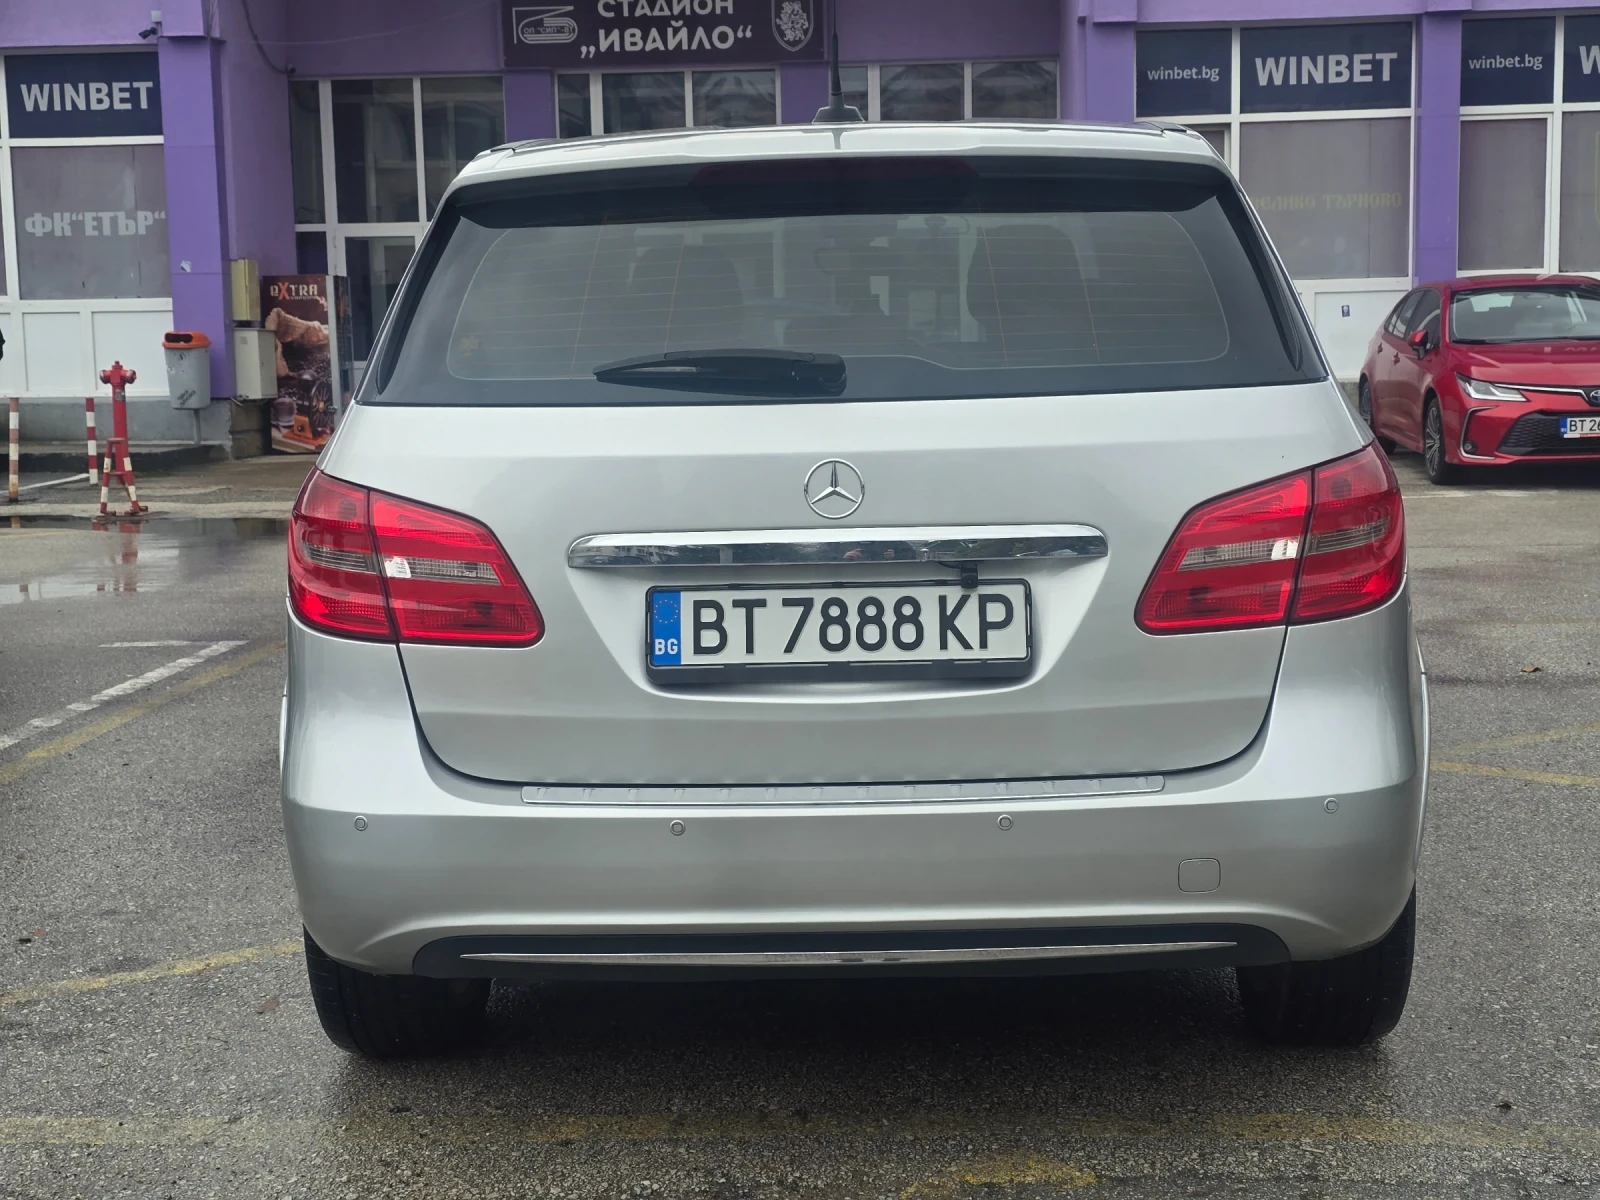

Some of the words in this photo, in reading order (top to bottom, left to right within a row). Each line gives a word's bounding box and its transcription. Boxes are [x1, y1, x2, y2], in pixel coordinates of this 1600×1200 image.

[597, 0, 734, 18] СТАДИОН
[1255, 52, 1398, 87] WINBET
[1468, 53, 1543, 71] winbet.bg
[1147, 65, 1220, 82] winbet.bg
[20, 81, 154, 112] WINBET
[1569, 419, 1586, 433] BT
[692, 597, 767, 655] BT
[781, 595, 924, 654] 7888
[938, 593, 1014, 651] KP
[654, 638, 679, 655] BG
